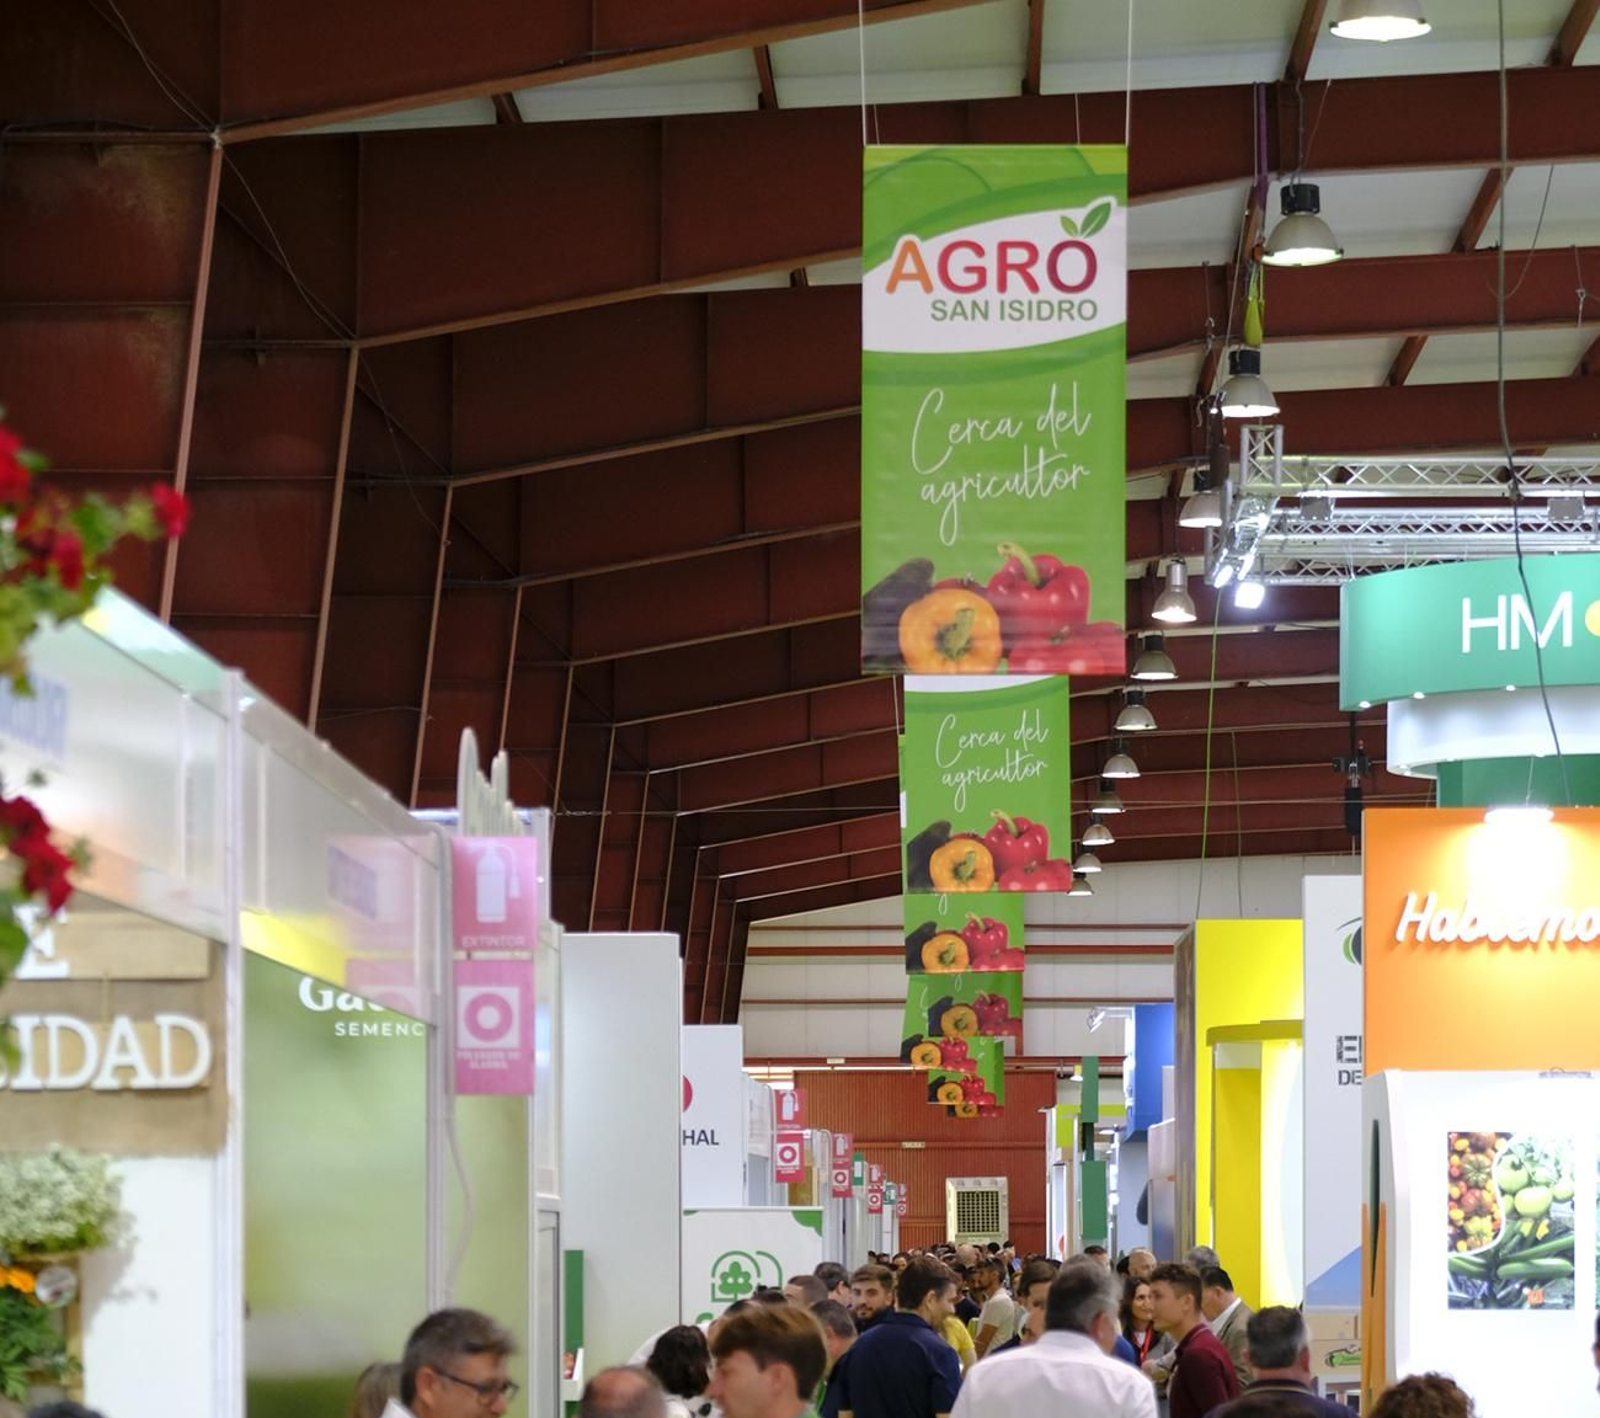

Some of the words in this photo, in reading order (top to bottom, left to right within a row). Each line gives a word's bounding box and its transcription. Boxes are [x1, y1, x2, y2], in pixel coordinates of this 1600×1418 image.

[885, 239, 1099, 294] AGRO
[930, 300, 990, 322] SAN
[1000, 299, 1099, 322] ISIDRO
[911, 388, 1023, 475] Cerca
[1036, 381, 1092, 451] del
[921, 444, 1091, 547] agricultor
[1462, 591, 1572, 653] HM
[935, 713, 1007, 769] Cerca
[1013, 708, 1049, 751] del
[942, 748, 1048, 813] agricultor
[298, 976, 385, 1012] Ga
[0, 1014, 211, 1090] IDAD
[334, 1021, 426, 1037] SEMENC
[682, 1129, 719, 1146] HAL
